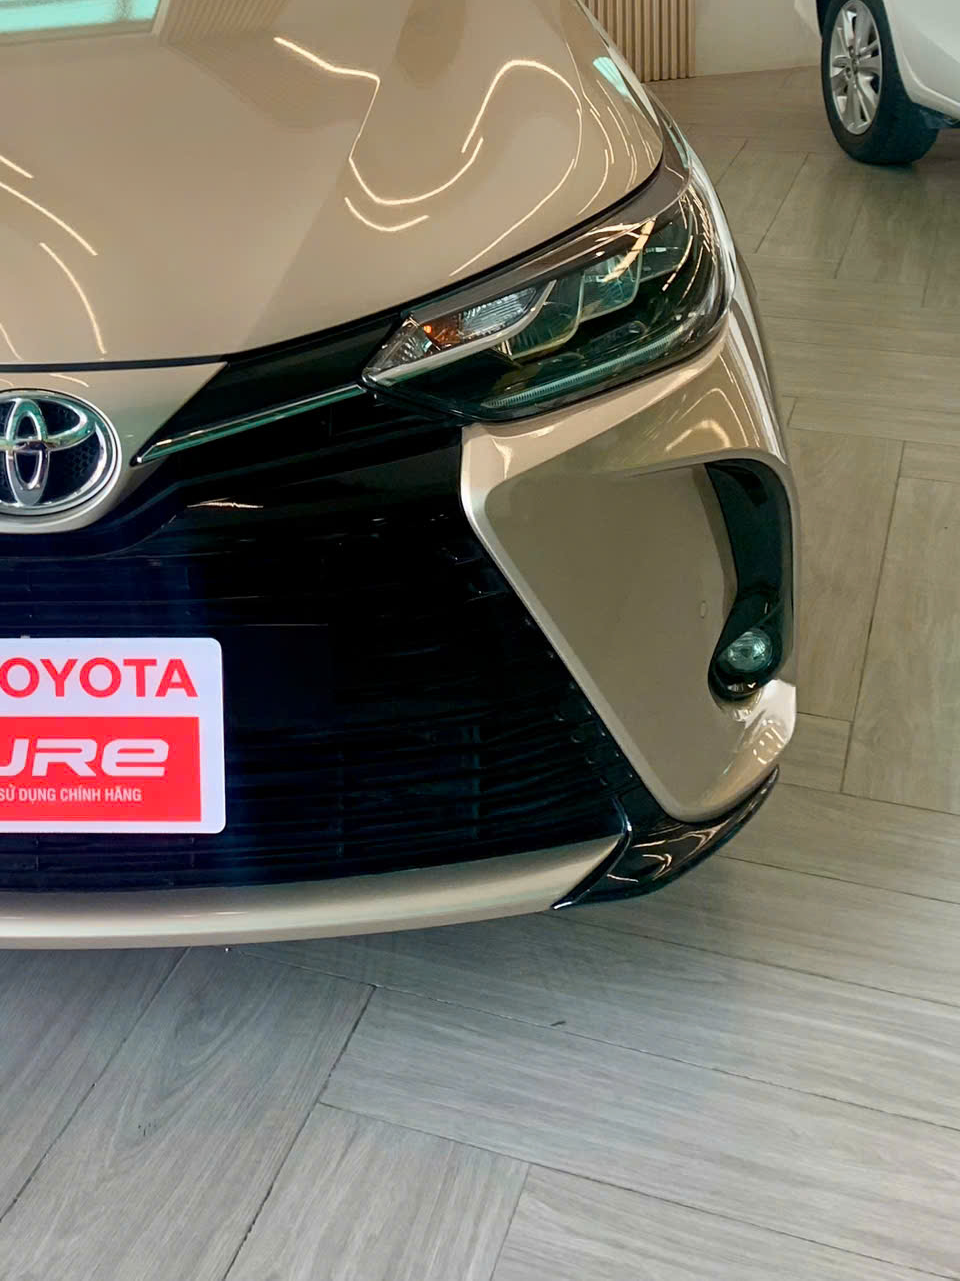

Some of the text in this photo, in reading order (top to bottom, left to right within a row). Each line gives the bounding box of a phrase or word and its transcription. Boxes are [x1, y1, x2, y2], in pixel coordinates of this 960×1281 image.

[19, 788, 56, 805] DỤNG
[60, 785, 101, 802] CHÍNH
[104, 786, 142, 802] HÃNG
